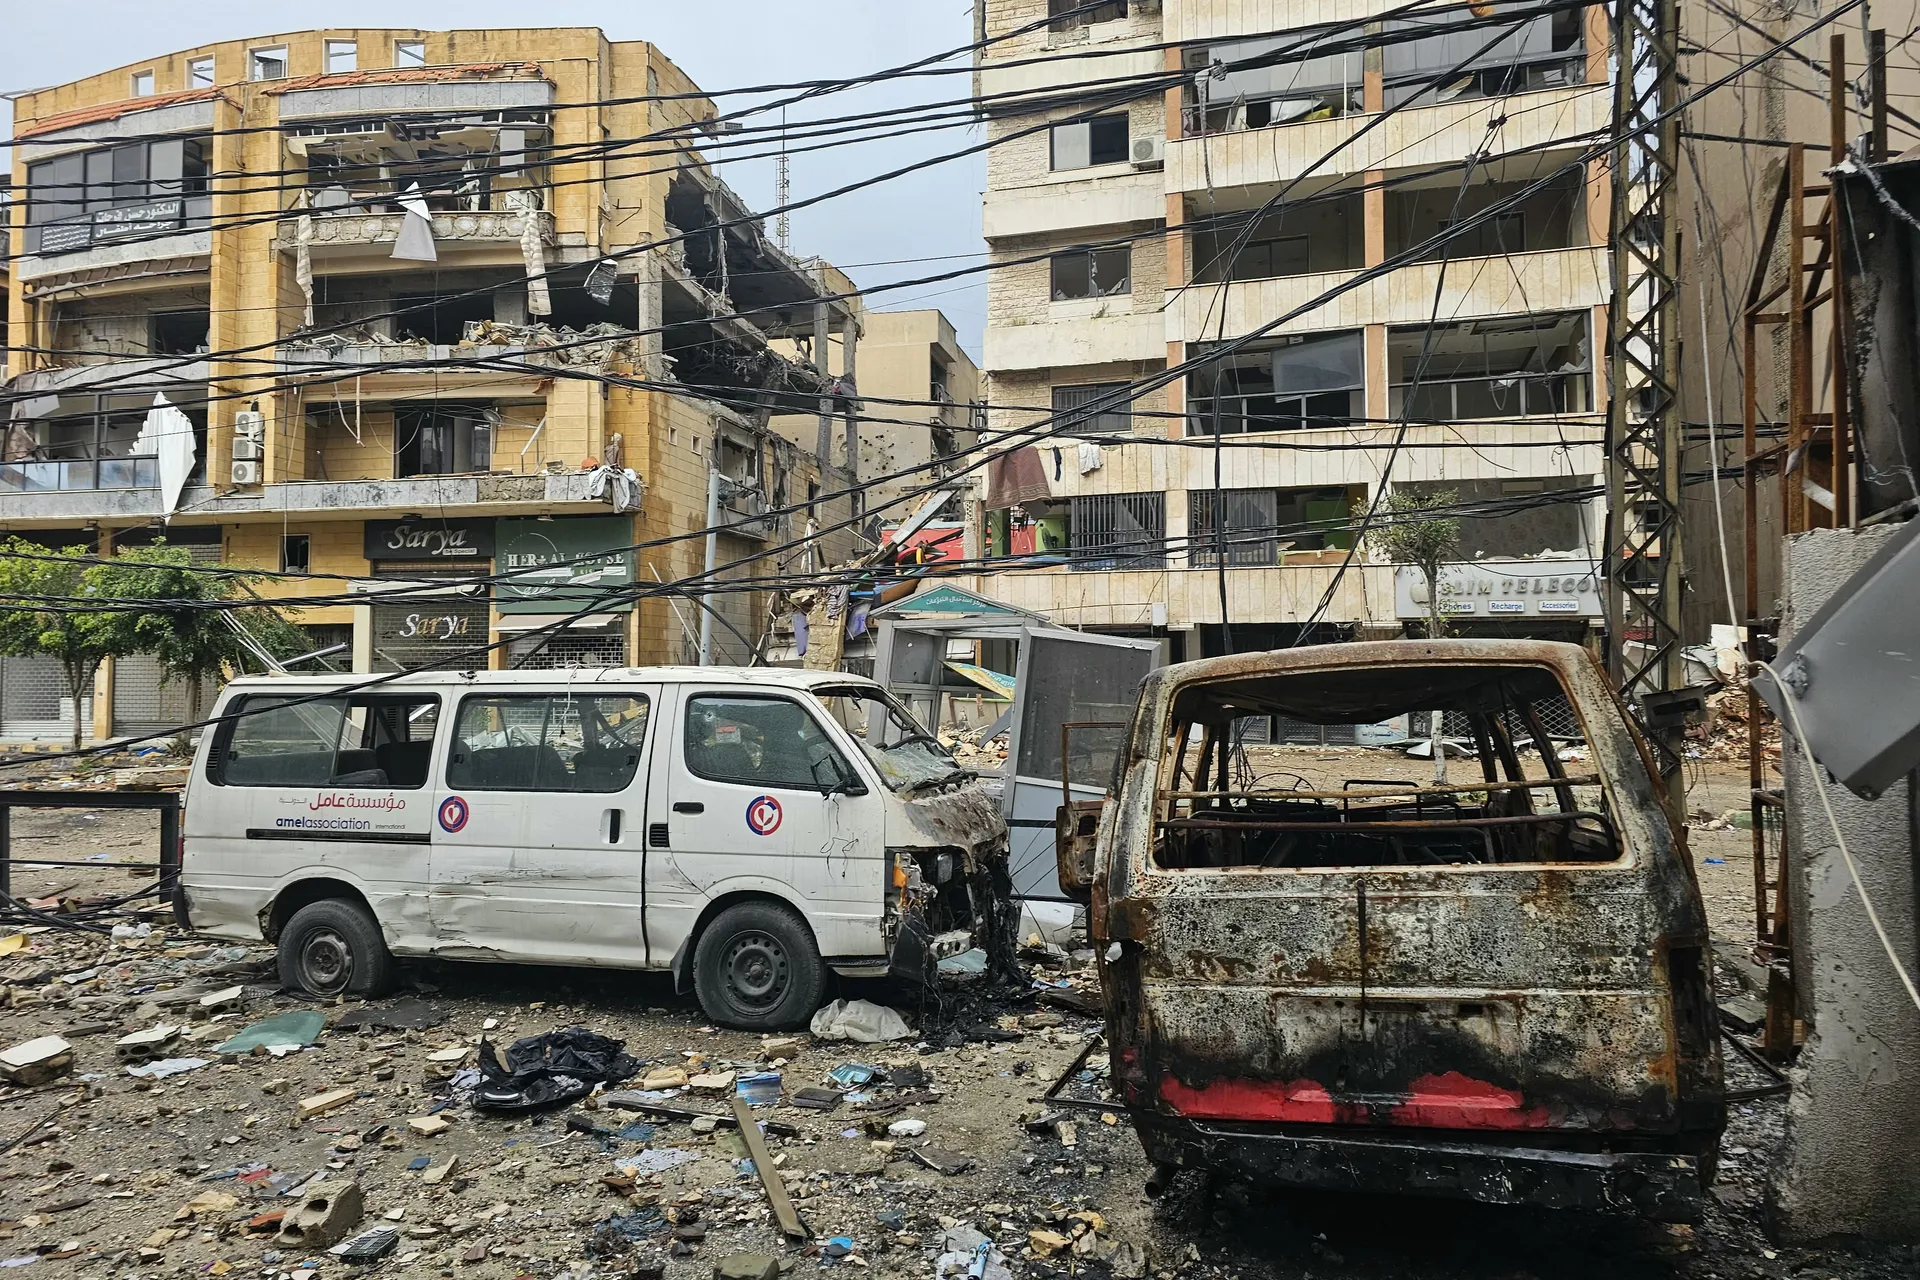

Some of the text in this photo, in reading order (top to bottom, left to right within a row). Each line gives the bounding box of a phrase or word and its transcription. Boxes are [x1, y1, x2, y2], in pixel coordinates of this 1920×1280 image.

[96, 202, 179, 222] الدكتور حسن فرحات
[387, 525, 467, 555] Sarya
[1491, 602, 1523, 611] Recharge
[1541, 602, 1577, 610] Accessories
[399, 613, 469, 640] Sarya
[309, 793, 345, 811] عامل
[346, 792, 406, 813] مؤسسة
